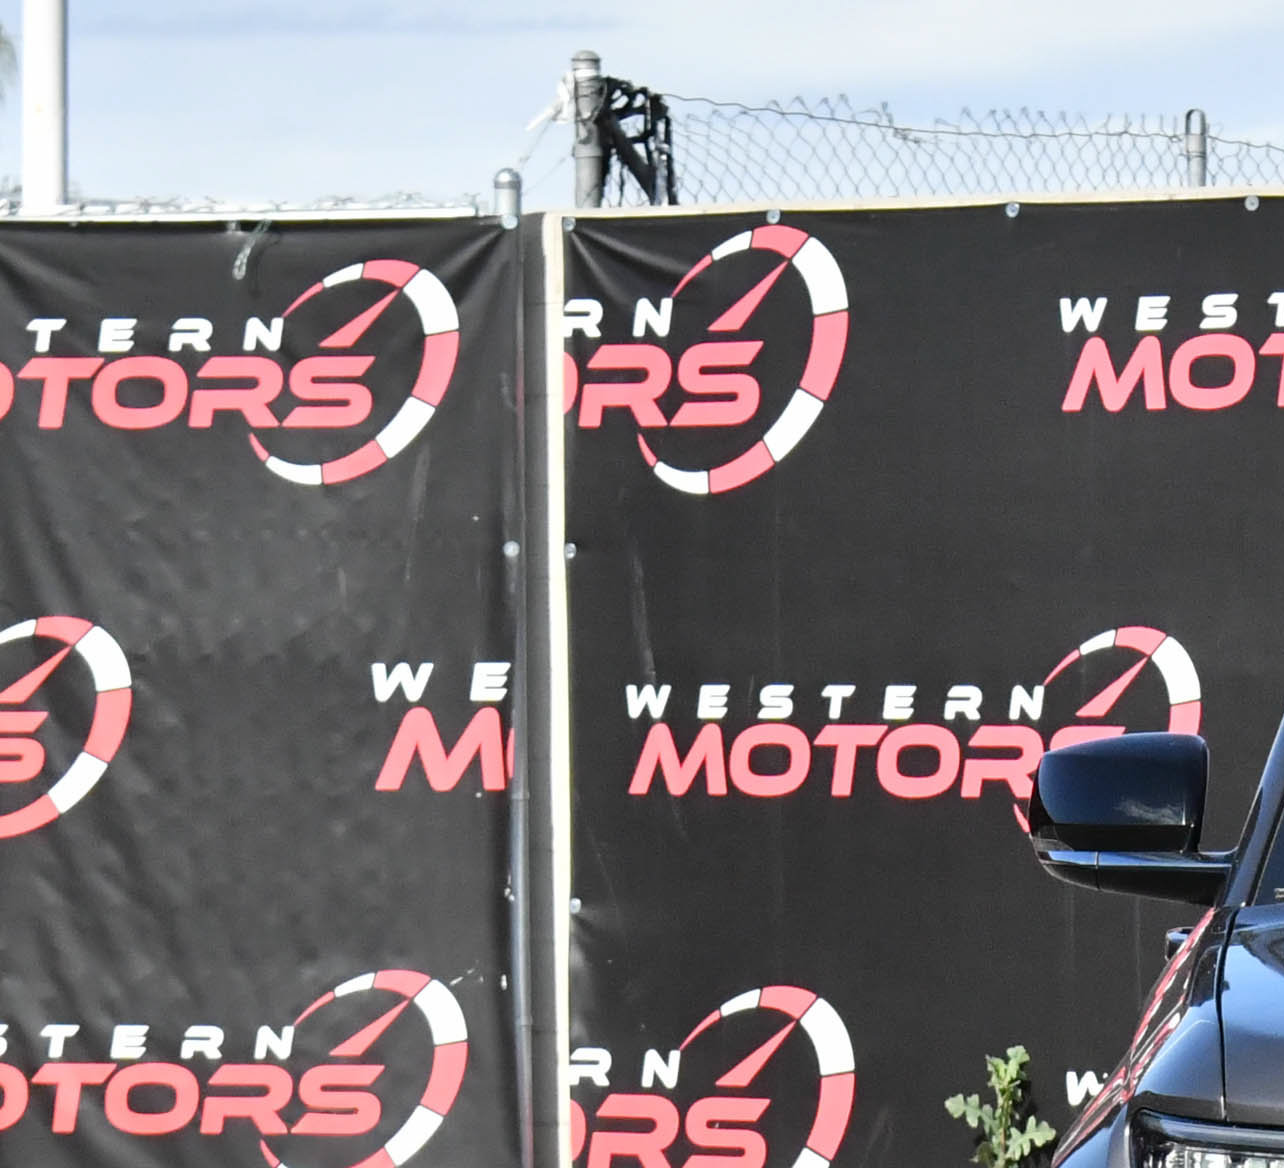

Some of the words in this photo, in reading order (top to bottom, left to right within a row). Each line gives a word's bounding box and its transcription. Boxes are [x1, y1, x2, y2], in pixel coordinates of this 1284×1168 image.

[0, 356, 375, 429] TORS
[625, 684, 1044, 720] WESTERN
[629, 723, 1126, 799] MOTOR
[0, 1024, 294, 1060] TERN
